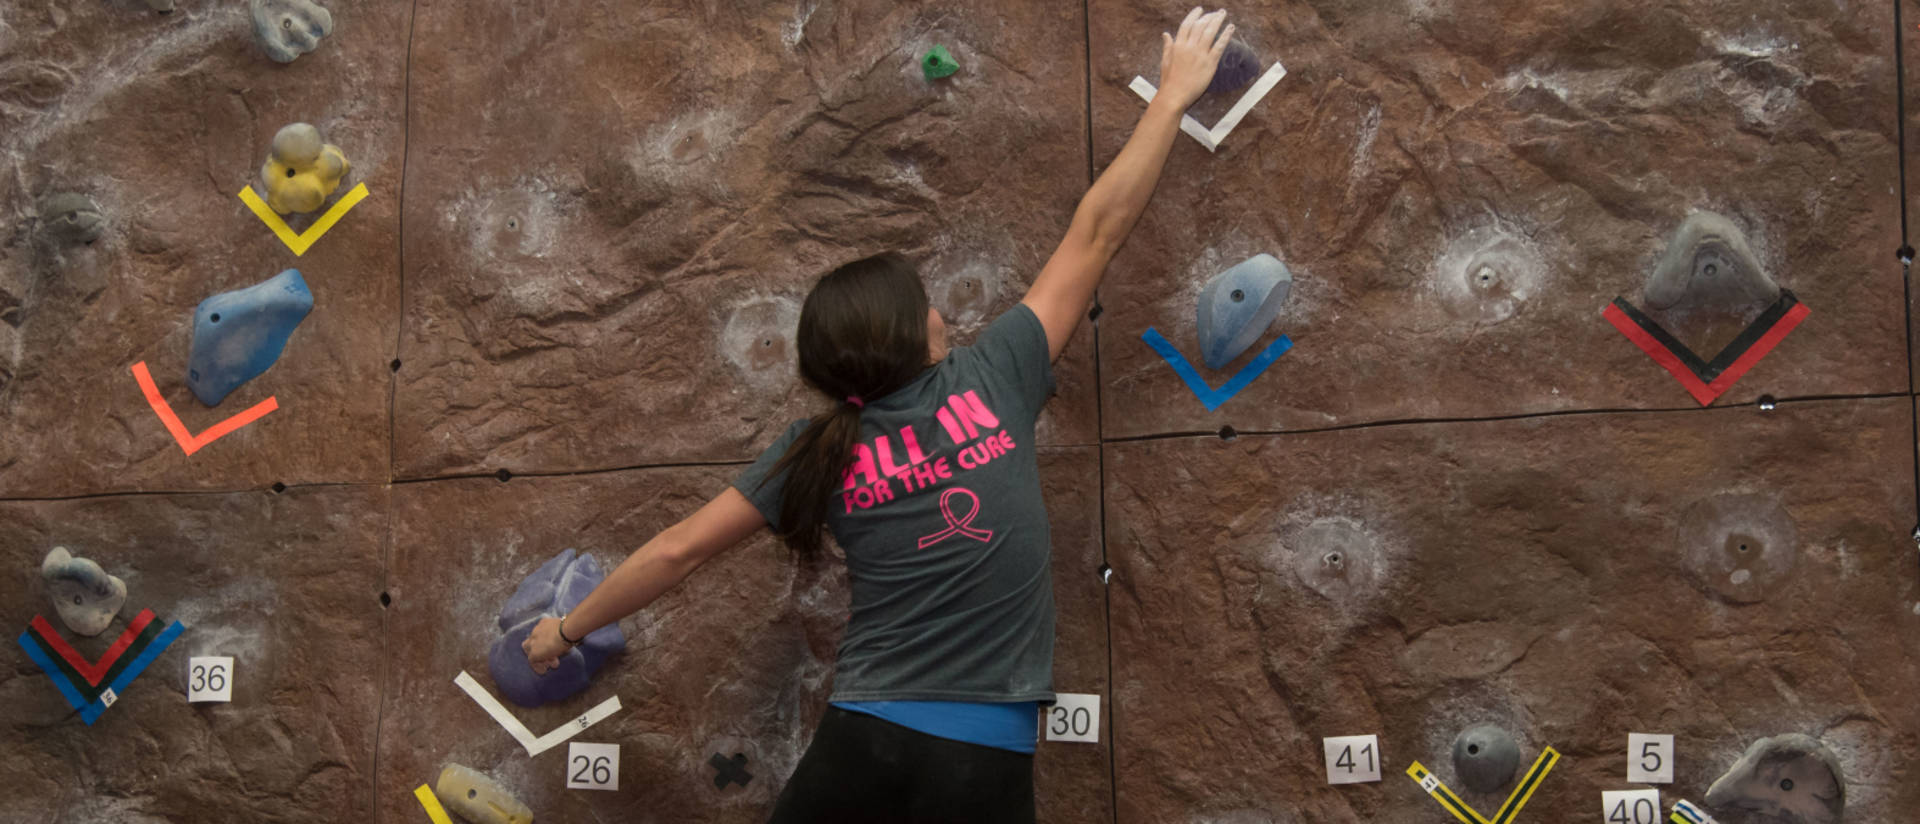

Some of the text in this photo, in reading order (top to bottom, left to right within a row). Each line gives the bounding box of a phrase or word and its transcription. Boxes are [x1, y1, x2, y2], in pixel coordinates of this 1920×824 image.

[842, 389, 999, 489] ALL IN
[843, 429, 1016, 515] FOR THE CURE
[191, 665, 226, 692] 36
[1051, 706, 1091, 736] 30
[571, 755, 611, 785] 26
[1335, 743, 1374, 773] 41
[1641, 742, 1662, 772] 5
[1608, 798, 1655, 824] 40
